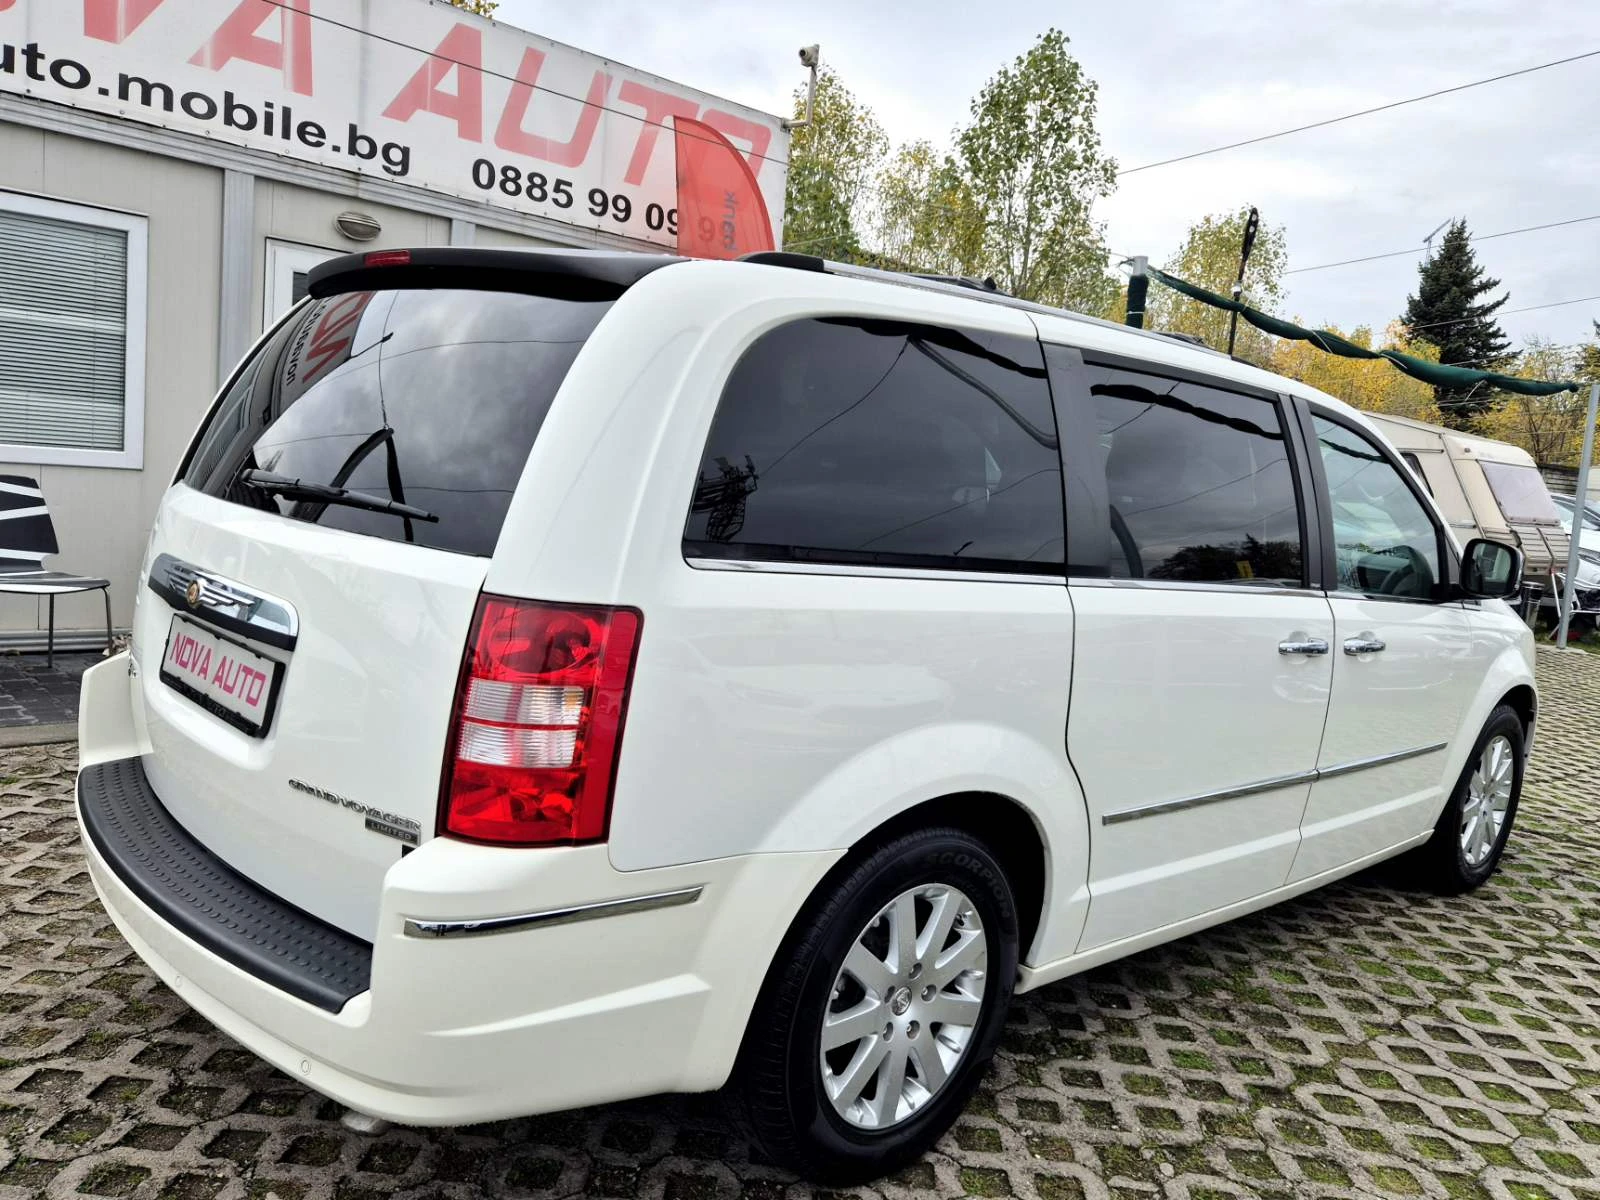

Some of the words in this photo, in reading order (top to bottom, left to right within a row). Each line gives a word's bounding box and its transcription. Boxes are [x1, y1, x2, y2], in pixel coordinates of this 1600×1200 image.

[472, 158, 573, 209] 0885
[588, 188, 632, 223] 99
[170, 632, 212, 680] NOVA
[212, 656, 266, 707] AUTO
[370, 820, 412, 841] LIMITED
